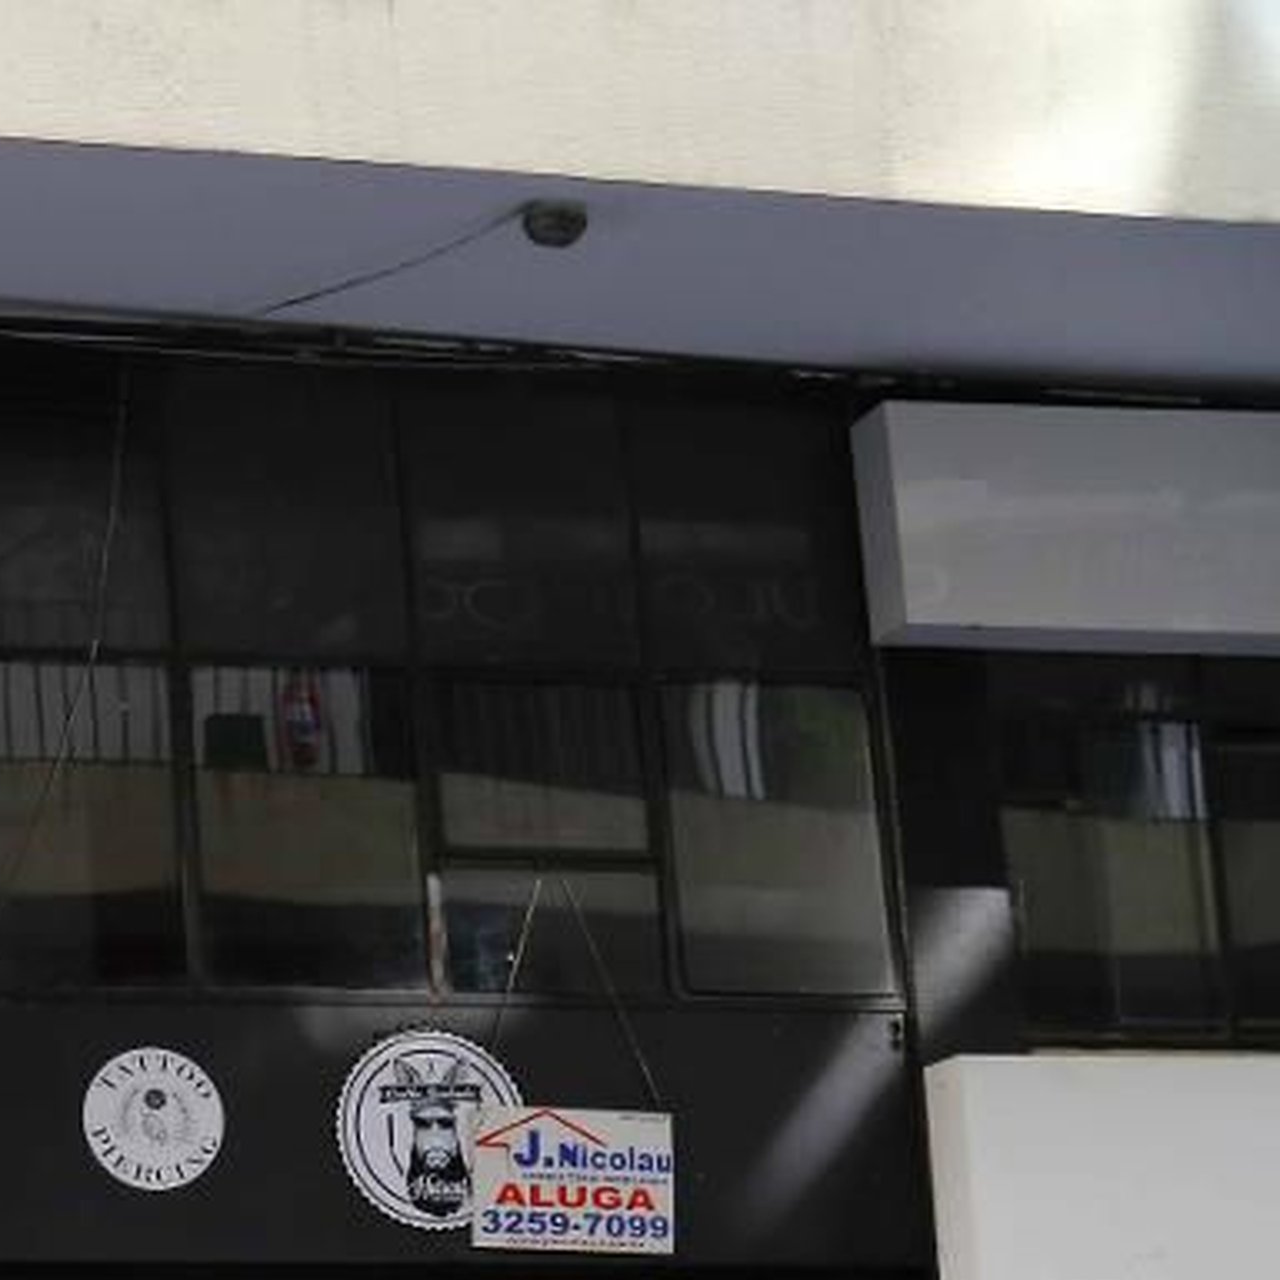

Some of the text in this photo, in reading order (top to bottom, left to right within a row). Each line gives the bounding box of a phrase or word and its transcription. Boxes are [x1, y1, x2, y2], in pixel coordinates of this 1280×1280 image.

[97, 1053, 213, 1099] TATTOO
[496, 1183, 655, 1210] ALUGA
[481, 1209, 669, 1238] 3259-7099
